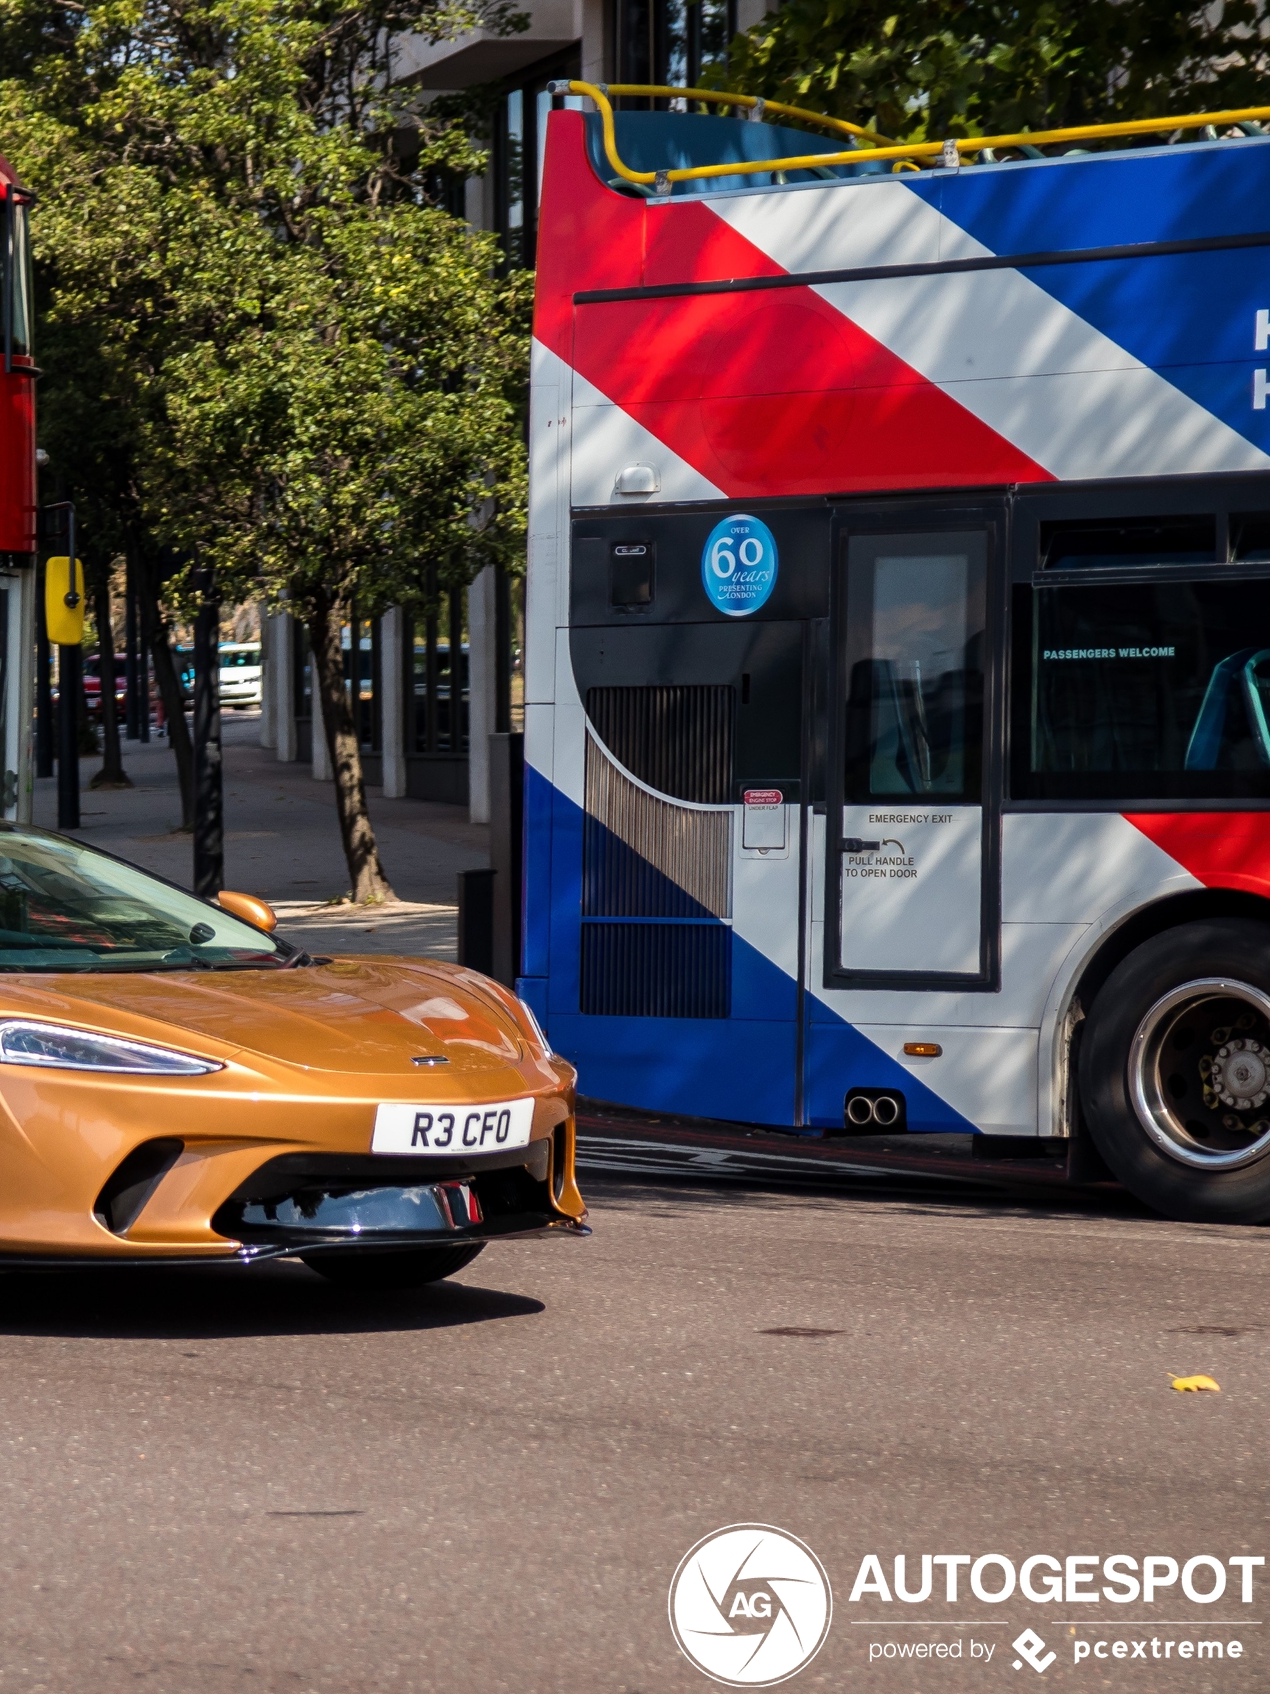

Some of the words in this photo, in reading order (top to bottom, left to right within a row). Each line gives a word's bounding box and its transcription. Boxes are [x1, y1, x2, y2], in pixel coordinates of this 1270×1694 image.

[711, 537, 763, 578] 60
[731, 570, 770, 585] years
[719, 584, 762, 592] PRESENTING
[1043, 648, 1116, 659] PASSENGERS
[1118, 646, 1175, 657] WELCOME
[869, 814, 929, 823] EMERGENCY
[931, 814, 952, 823] EXIT
[849, 857, 873, 866] PULL
[875, 857, 914, 866] HANDLE
[845, 869, 858, 877] TO
[861, 869, 887, 877] OPEN
[890, 869, 917, 878] DOOR
[411, 1112, 455, 1147] R3
[462, 1109, 511, 1147] CFO
